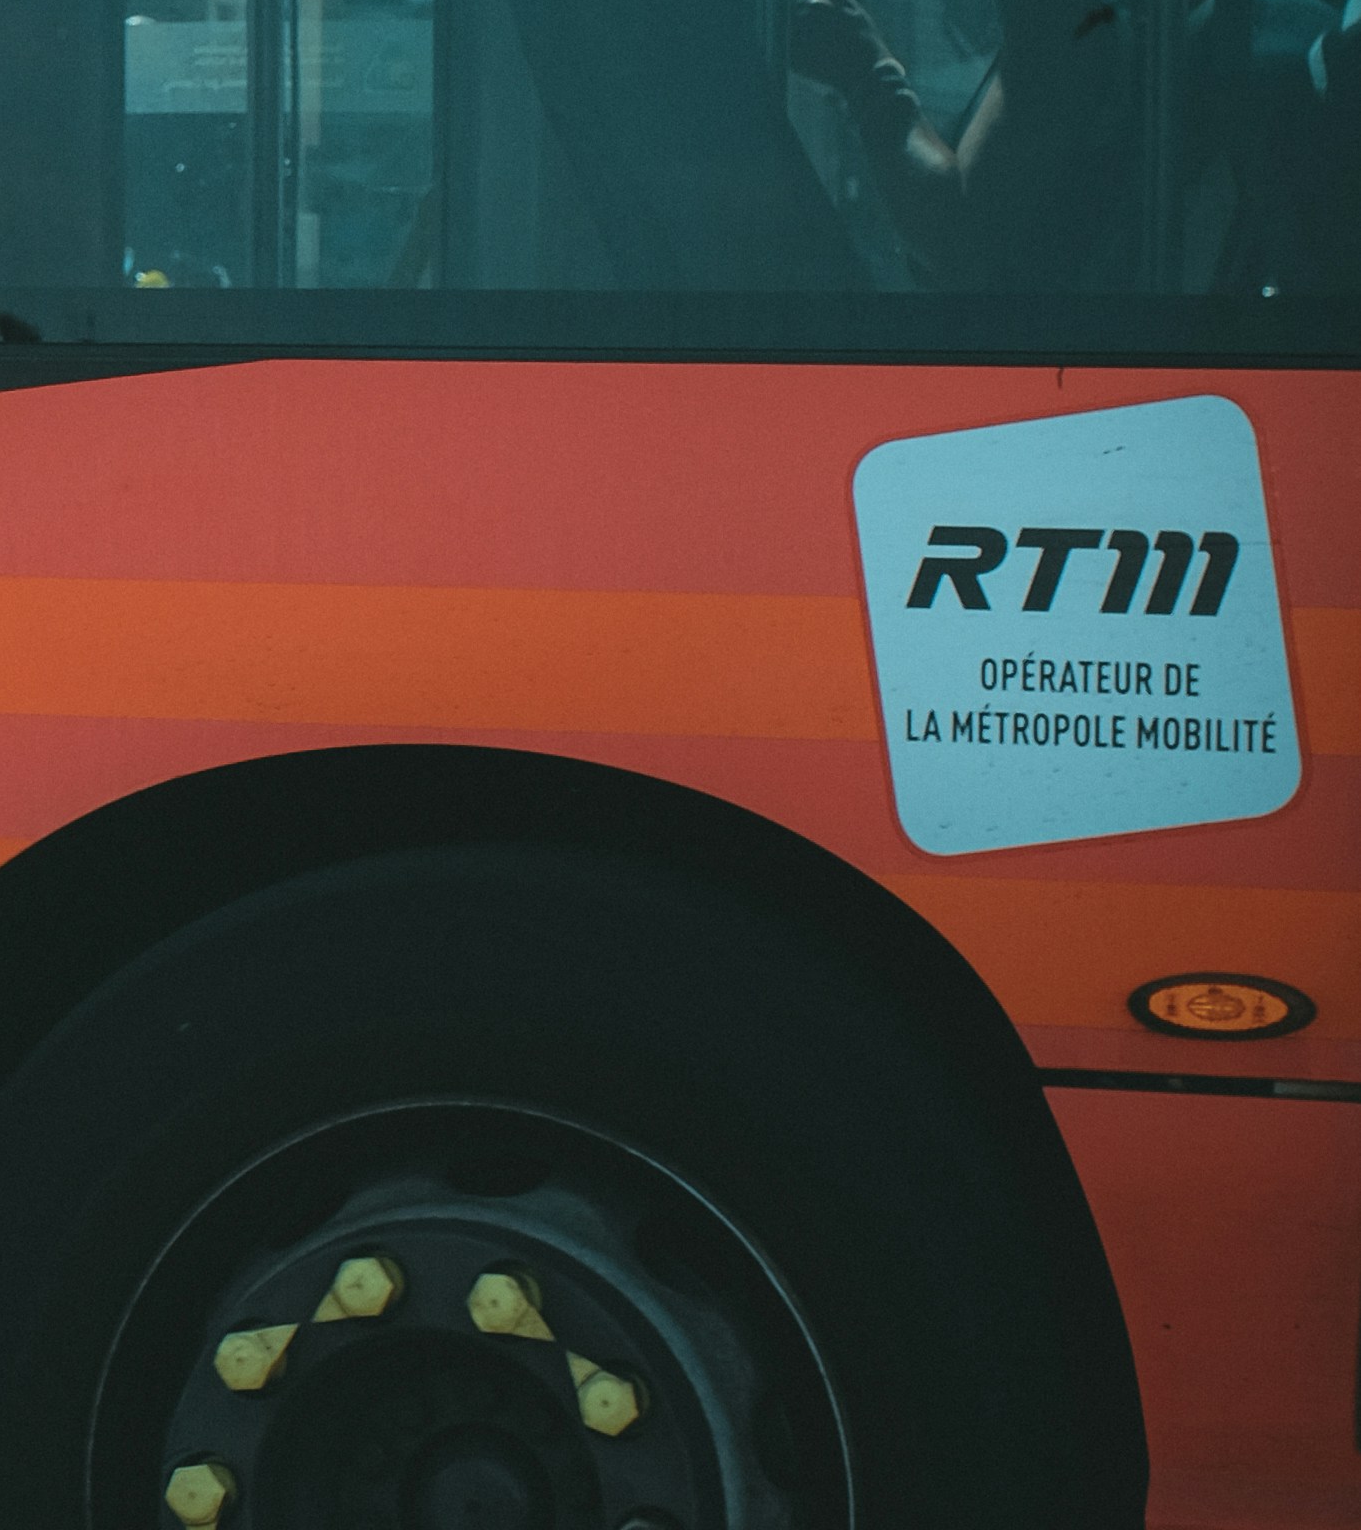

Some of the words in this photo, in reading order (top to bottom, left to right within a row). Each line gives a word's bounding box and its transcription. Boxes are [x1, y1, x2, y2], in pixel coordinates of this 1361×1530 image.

[980, 651, 1152, 696] OPÉRATEUR
[1165, 662, 1200, 697] DE
[906, 709, 941, 742] LA
[952, 704, 1126, 749] MÉTROPOLE
[1136, 712, 1277, 754] MOBILITÉ
